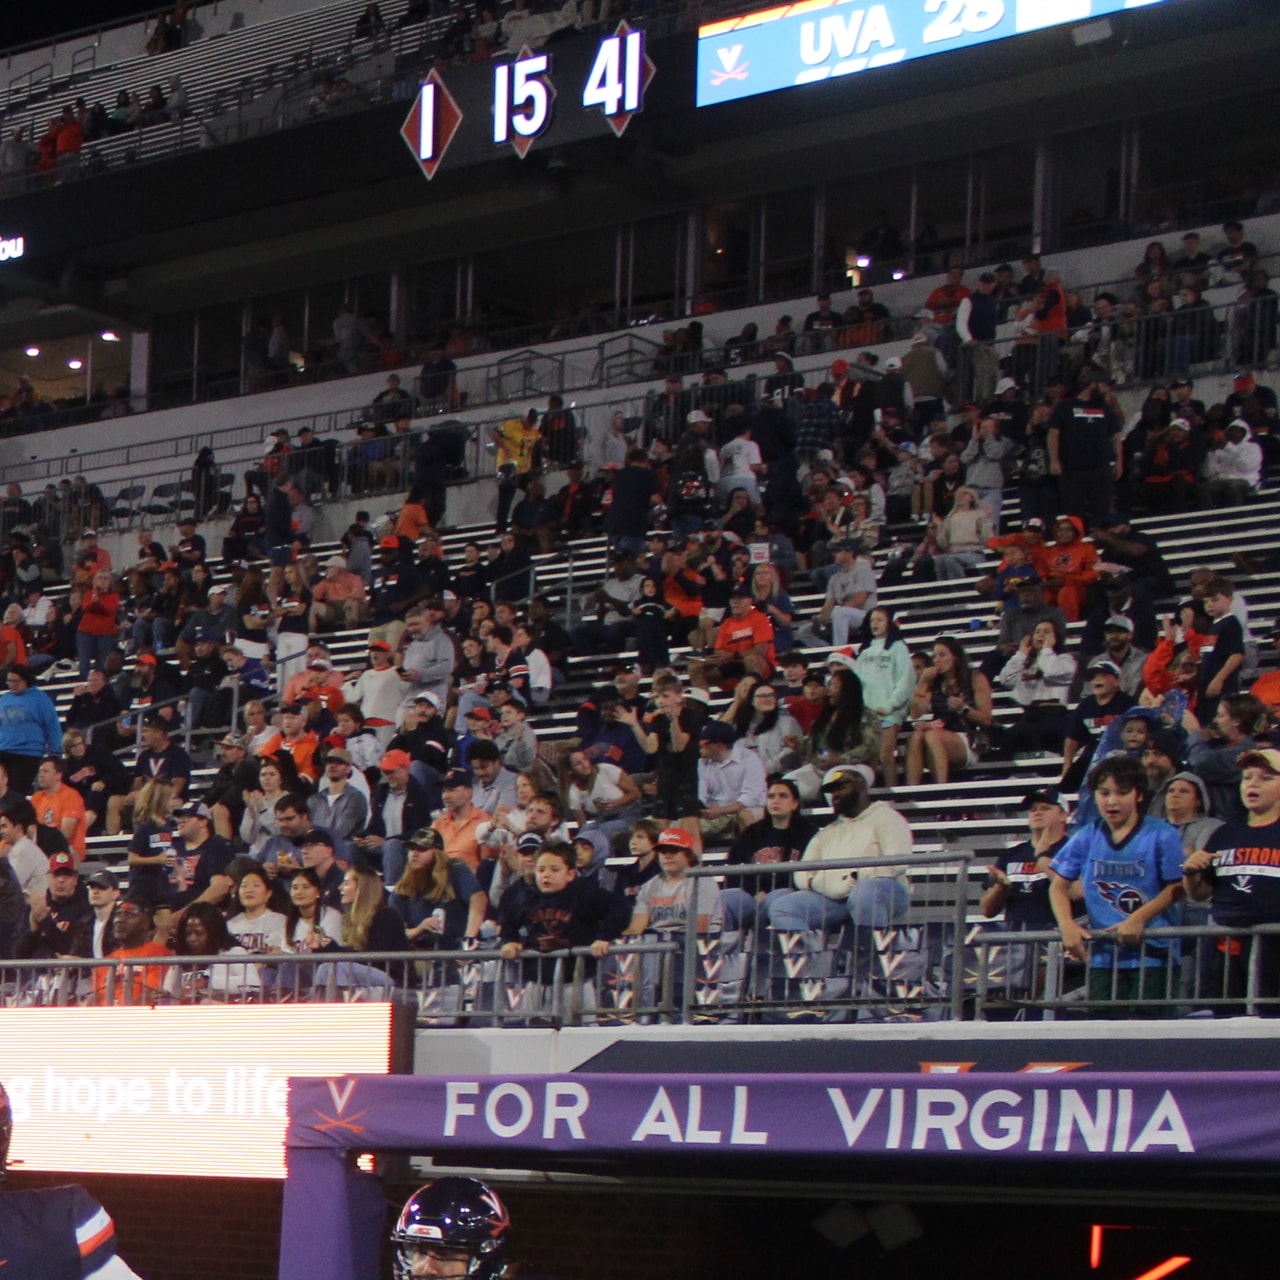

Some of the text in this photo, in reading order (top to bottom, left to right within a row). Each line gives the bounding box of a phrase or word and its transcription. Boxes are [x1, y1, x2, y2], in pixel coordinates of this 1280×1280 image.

[800, 4, 896, 65] UVA
[493, 53, 550, 144] 15
[583, 31, 641, 115] 41
[44, 1067, 157, 1122] hope
[165, 1073, 218, 1115] to
[223, 1066, 289, 1117] life
[443, 1081, 586, 1139] FOR
[630, 1085, 769, 1146] ALL
[826, 1087, 1196, 1154] VIRGINIA
